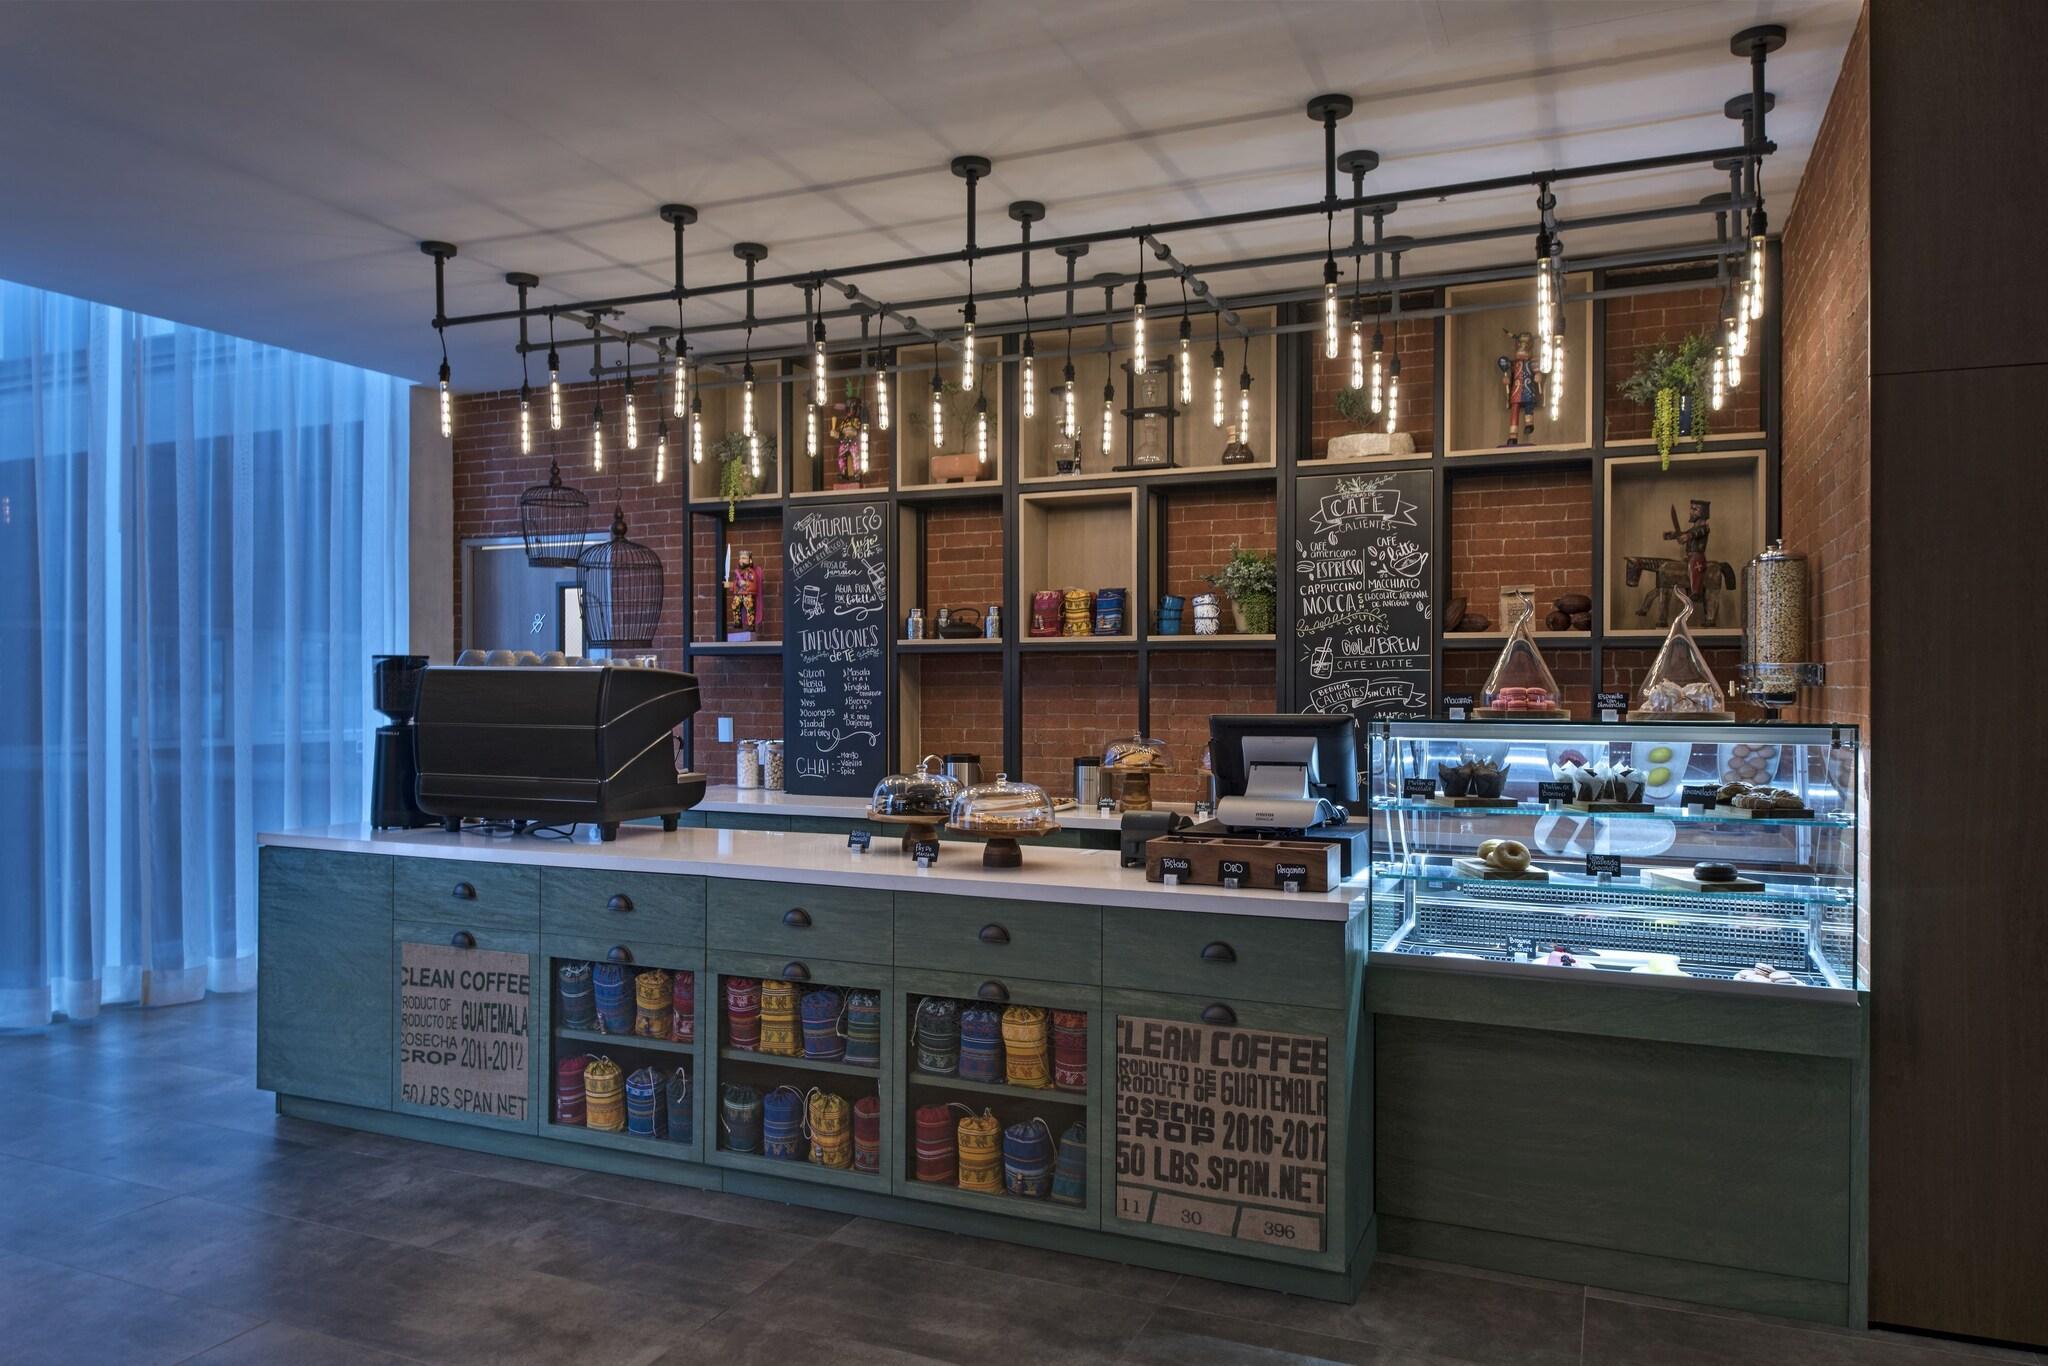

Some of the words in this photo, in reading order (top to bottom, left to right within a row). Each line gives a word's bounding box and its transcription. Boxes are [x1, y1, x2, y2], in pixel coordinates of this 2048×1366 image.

[805, 515, 869, 540] NATURALES
[1310, 549, 1356, 559] americano
[1316, 560, 1363, 579] ESPRESSO
[1300, 581, 1363, 596] CAPPUCCINO
[1368, 578, 1420, 590] MACCHIATO
[1303, 594, 1357, 616] MOCCA
[798, 624, 879, 653] INFUSIONES
[1377, 635, 1420, 655] BREW
[460, 970, 530, 995] COFFEE
[446, 1016, 457, 1031] DE
[461, 1001, 529, 1038] GUATEMALA
[1210, 1030, 1327, 1076] COFFEE
[1193, 1067, 1217, 1086] DE
[1117, 1075, 1189, 1099] RODUCT
[1193, 1085, 1217, 1102] OF
[1220, 1071, 1327, 1116] GUATEMALA
[453, 1088, 493, 1113] SPAN
[497, 1093, 527, 1120] NET
[1117, 1141, 1146, 1177] 50
[1181, 1209, 1202, 1225] 30
[1263, 1221, 1296, 1239] 396
